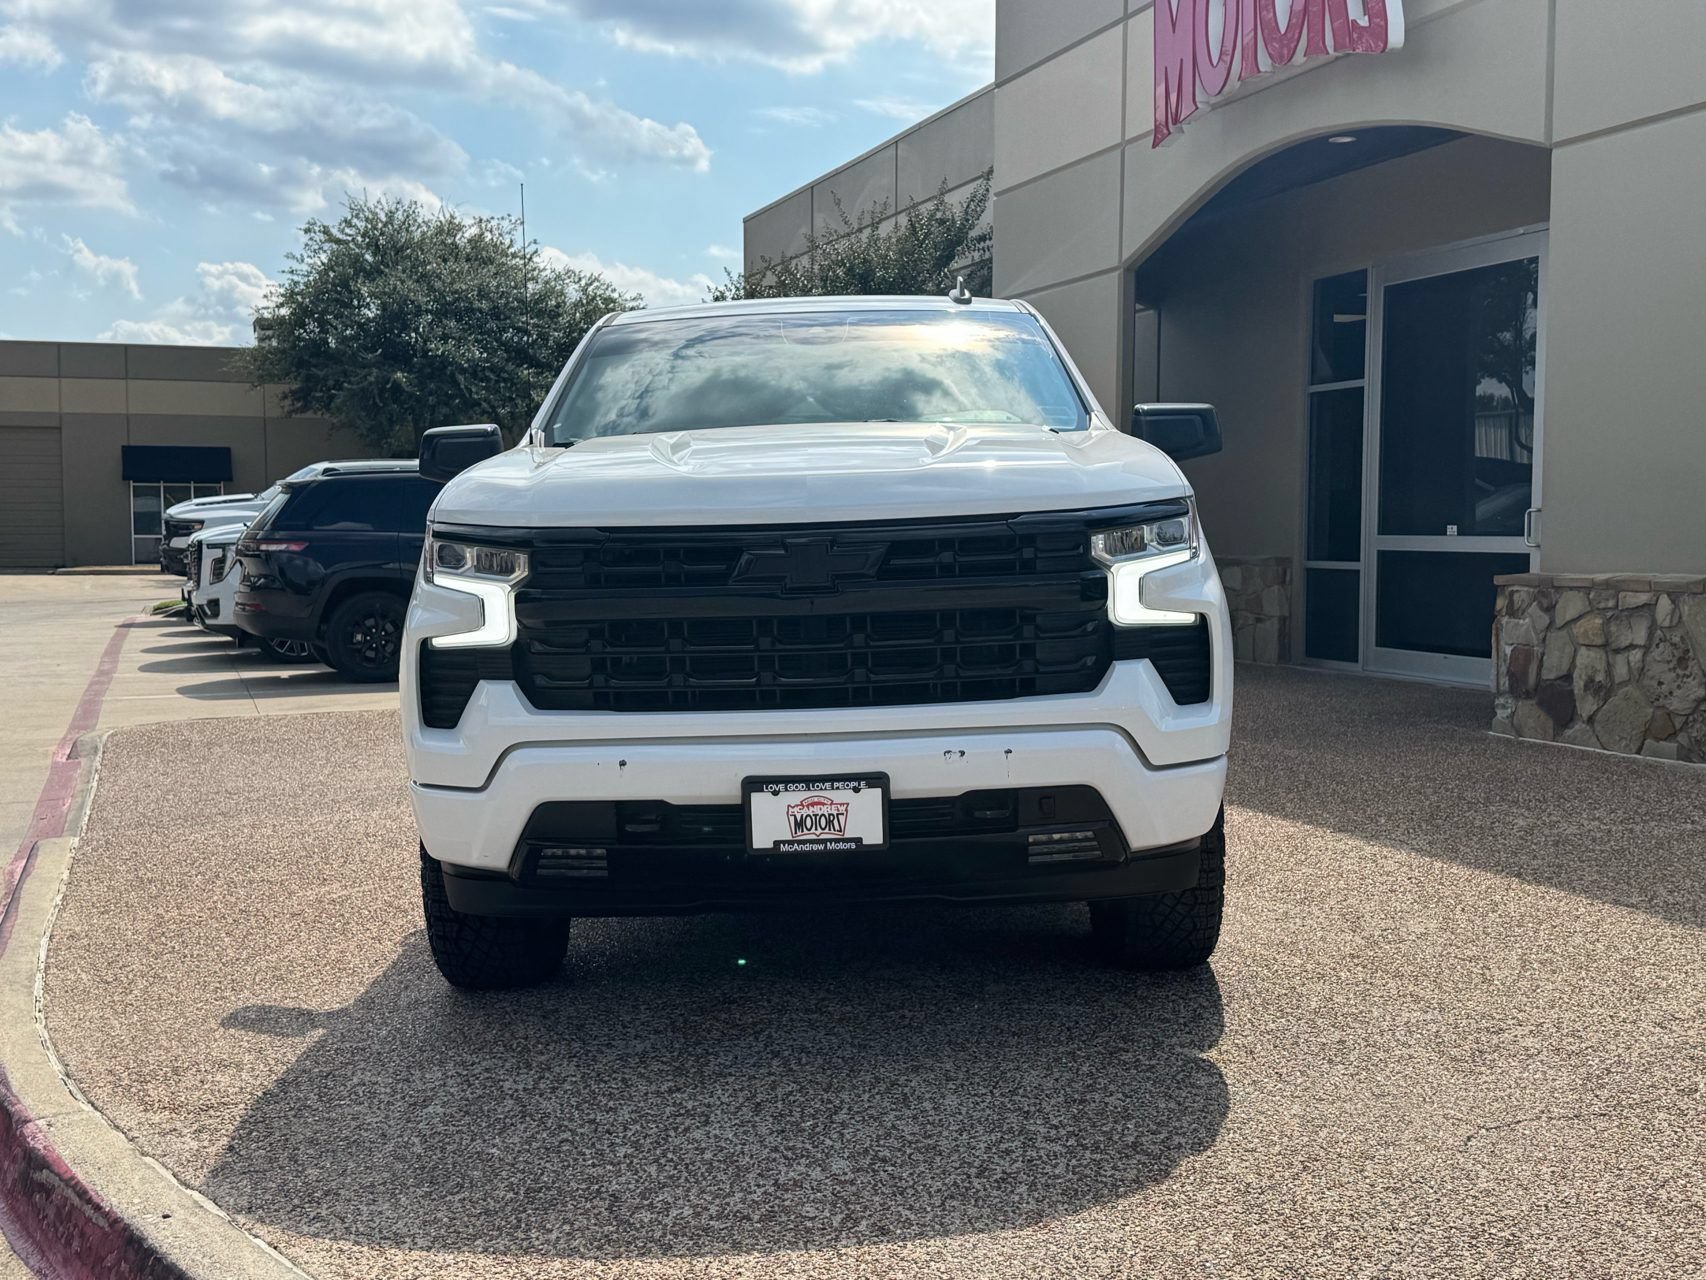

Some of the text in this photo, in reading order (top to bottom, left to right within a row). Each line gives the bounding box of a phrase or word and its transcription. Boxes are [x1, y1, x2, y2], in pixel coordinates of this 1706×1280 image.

[763, 784, 786, 792] LOVE
[787, 783, 808, 791] GOD.
[810, 782, 832, 790] LOVE
[790, 813, 844, 835] MOTORS
[780, 841, 856, 852] McAndrew Motors
